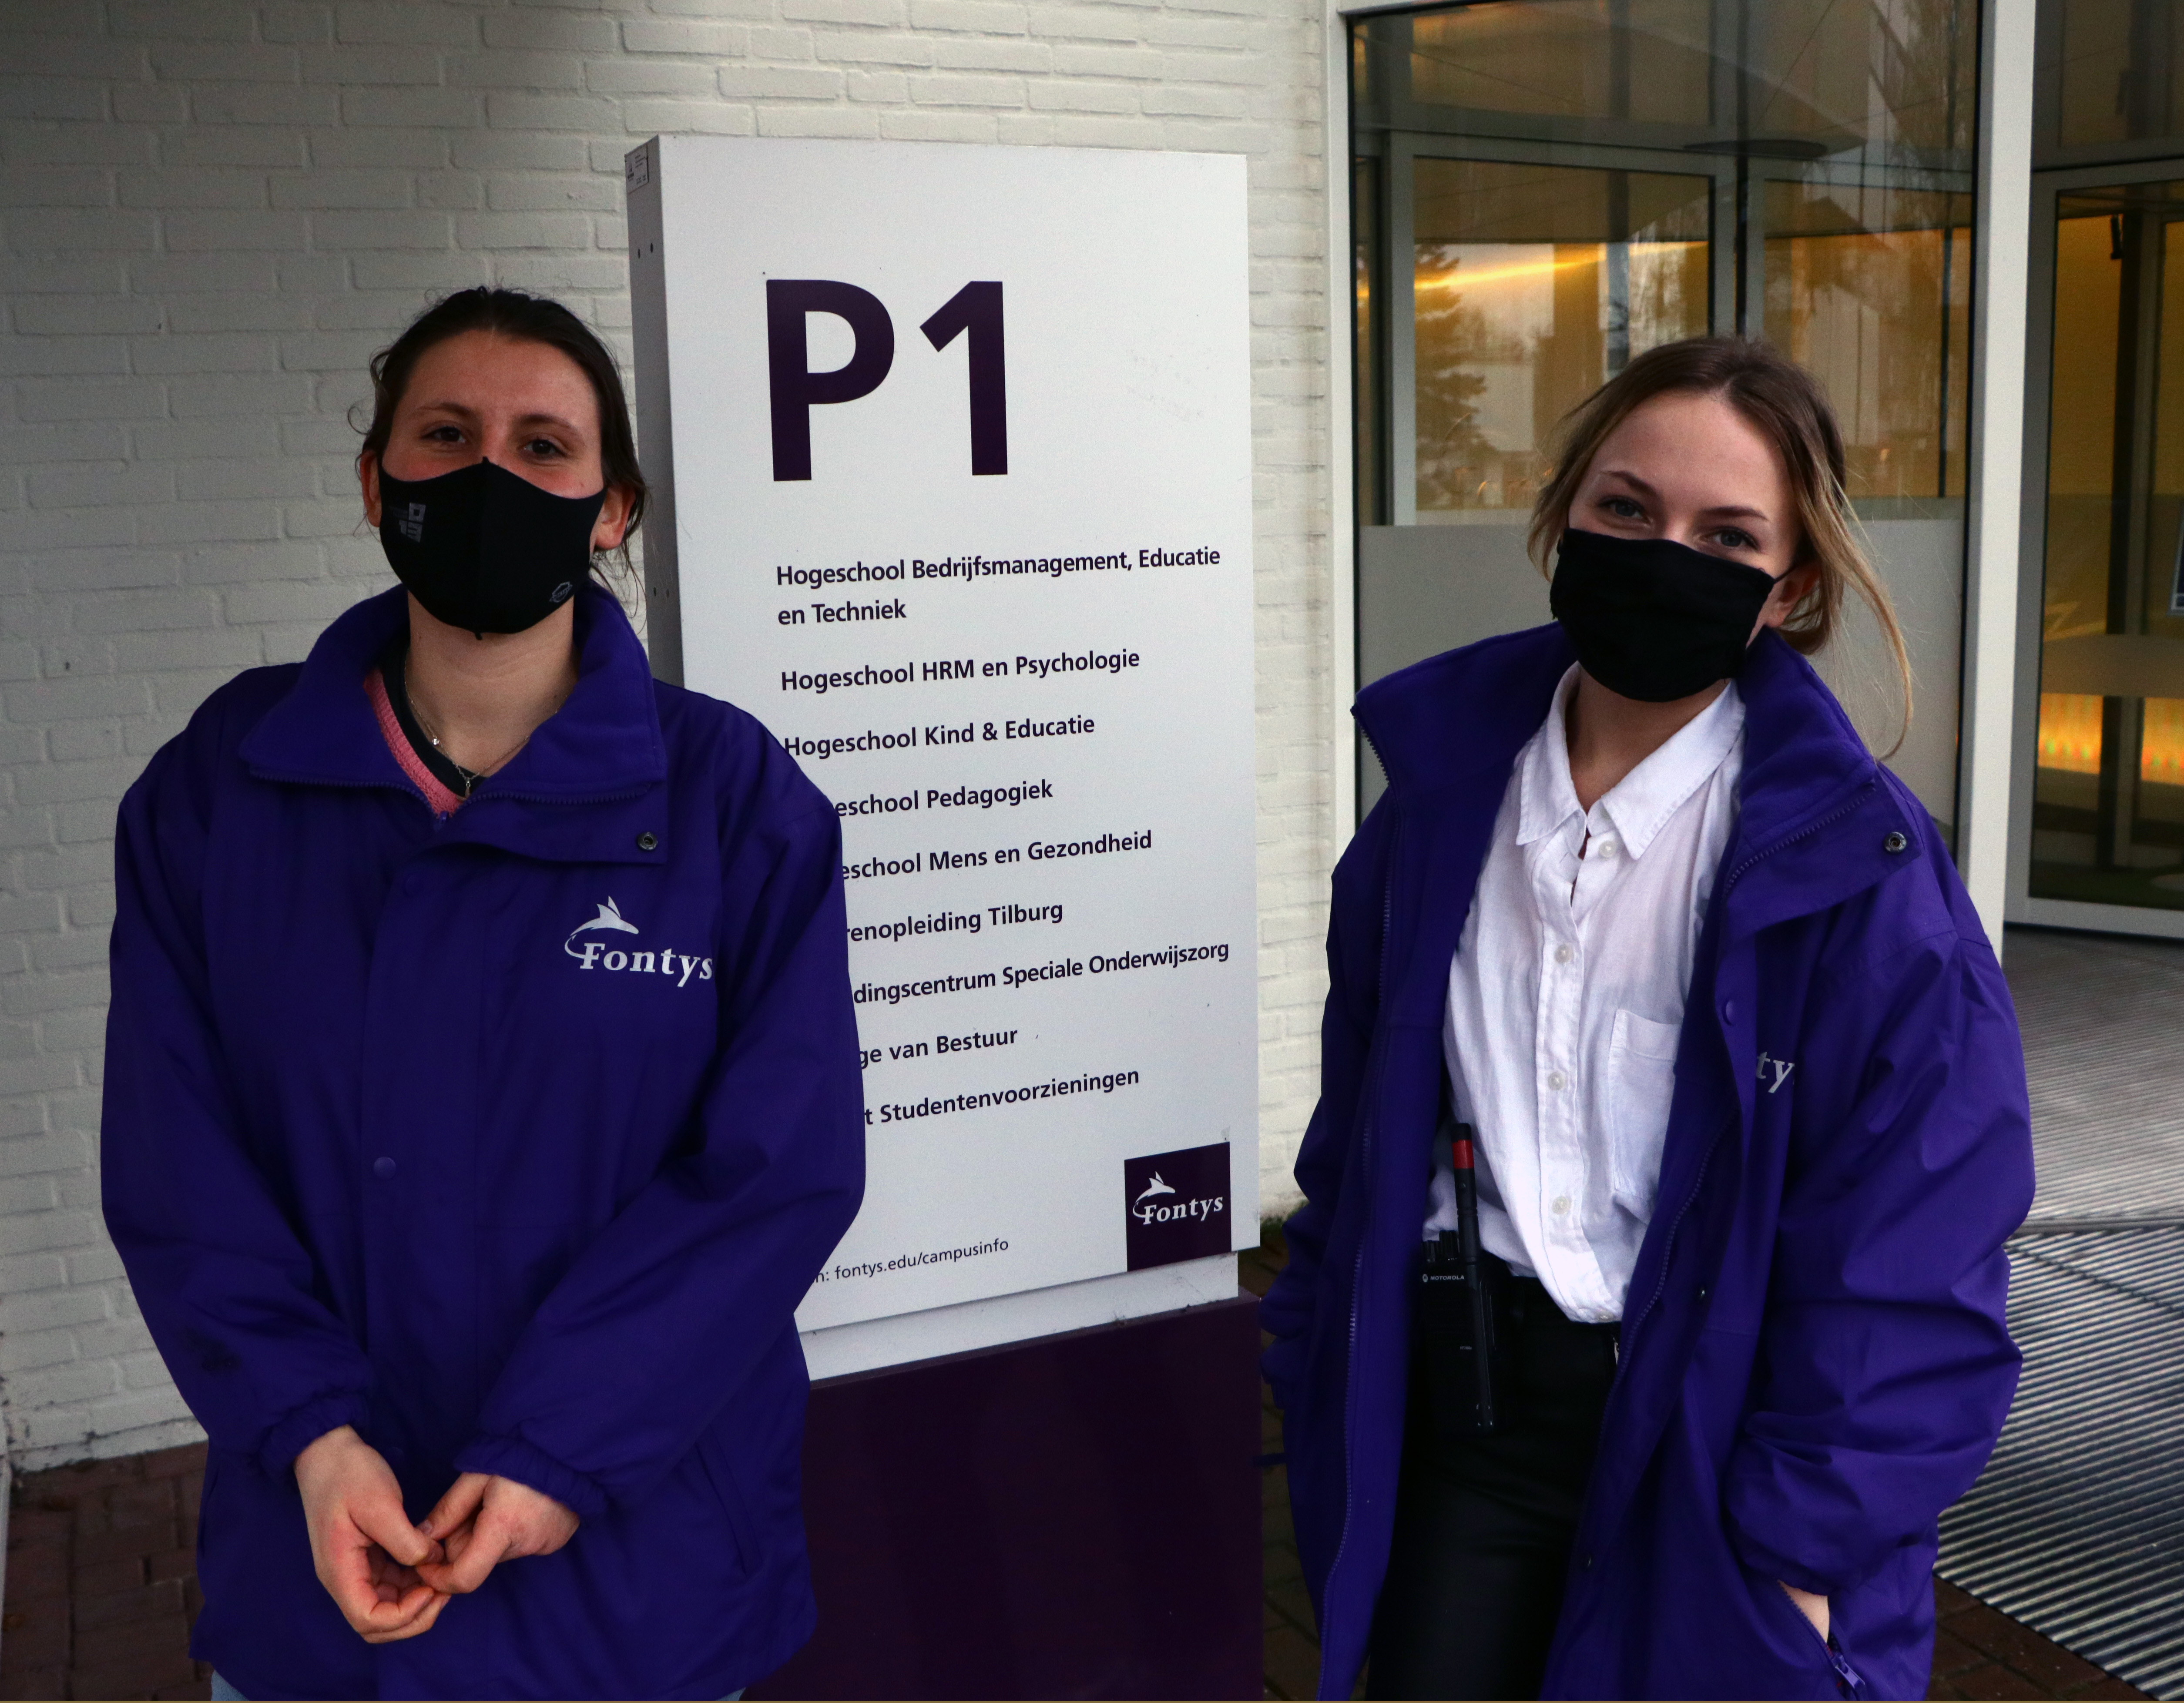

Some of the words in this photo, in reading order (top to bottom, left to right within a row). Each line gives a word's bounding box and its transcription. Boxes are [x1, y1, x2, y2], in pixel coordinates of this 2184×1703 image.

[766, 279, 1008, 482] P1
[777, 559, 905, 590] Hogeschool
[913, 552, 1132, 582] Bedrijfsmanagement,
[1139, 546, 1220, 568] Educatie
[778, 609, 805, 625] en
[811, 598, 907, 623] Techniek
[782, 662, 914, 694] Hogeschool
[923, 659, 974, 681] HRM
[982, 662, 1008, 677] en
[1016, 648, 1140, 678] Psychologie
[785, 727, 916, 760] Hogeschool
[925, 722, 974, 745] Kind
[982, 722, 998, 741] &
[1006, 714, 1095, 739] Educatie
[835, 790, 919, 816] eschool
[927, 778, 1053, 809] Pedagogiek
[842, 852, 921, 879] eschool
[929, 851, 987, 871] Mens
[995, 848, 1020, 864] en
[1028, 829, 1151, 860] Gezondheid
[846, 912, 981, 942] enopleiding
[987, 904, 1063, 925] Tilburg
[580, 942, 713, 988] Fontys
[853, 973, 996, 1005] dingscentrum
[1003, 958, 1083, 989] Speciale
[1089, 944, 1228, 973] Onderwijszorg
[889, 1042, 928, 1060] van
[936, 1030, 1018, 1054] Bestuur
[880, 1071, 1139, 1123] Studentenvoorzieningen
[1143, 1196, 1223, 1225] Fontys
[835, 1238, 1009, 1280] fontys.edu/campusinfo
